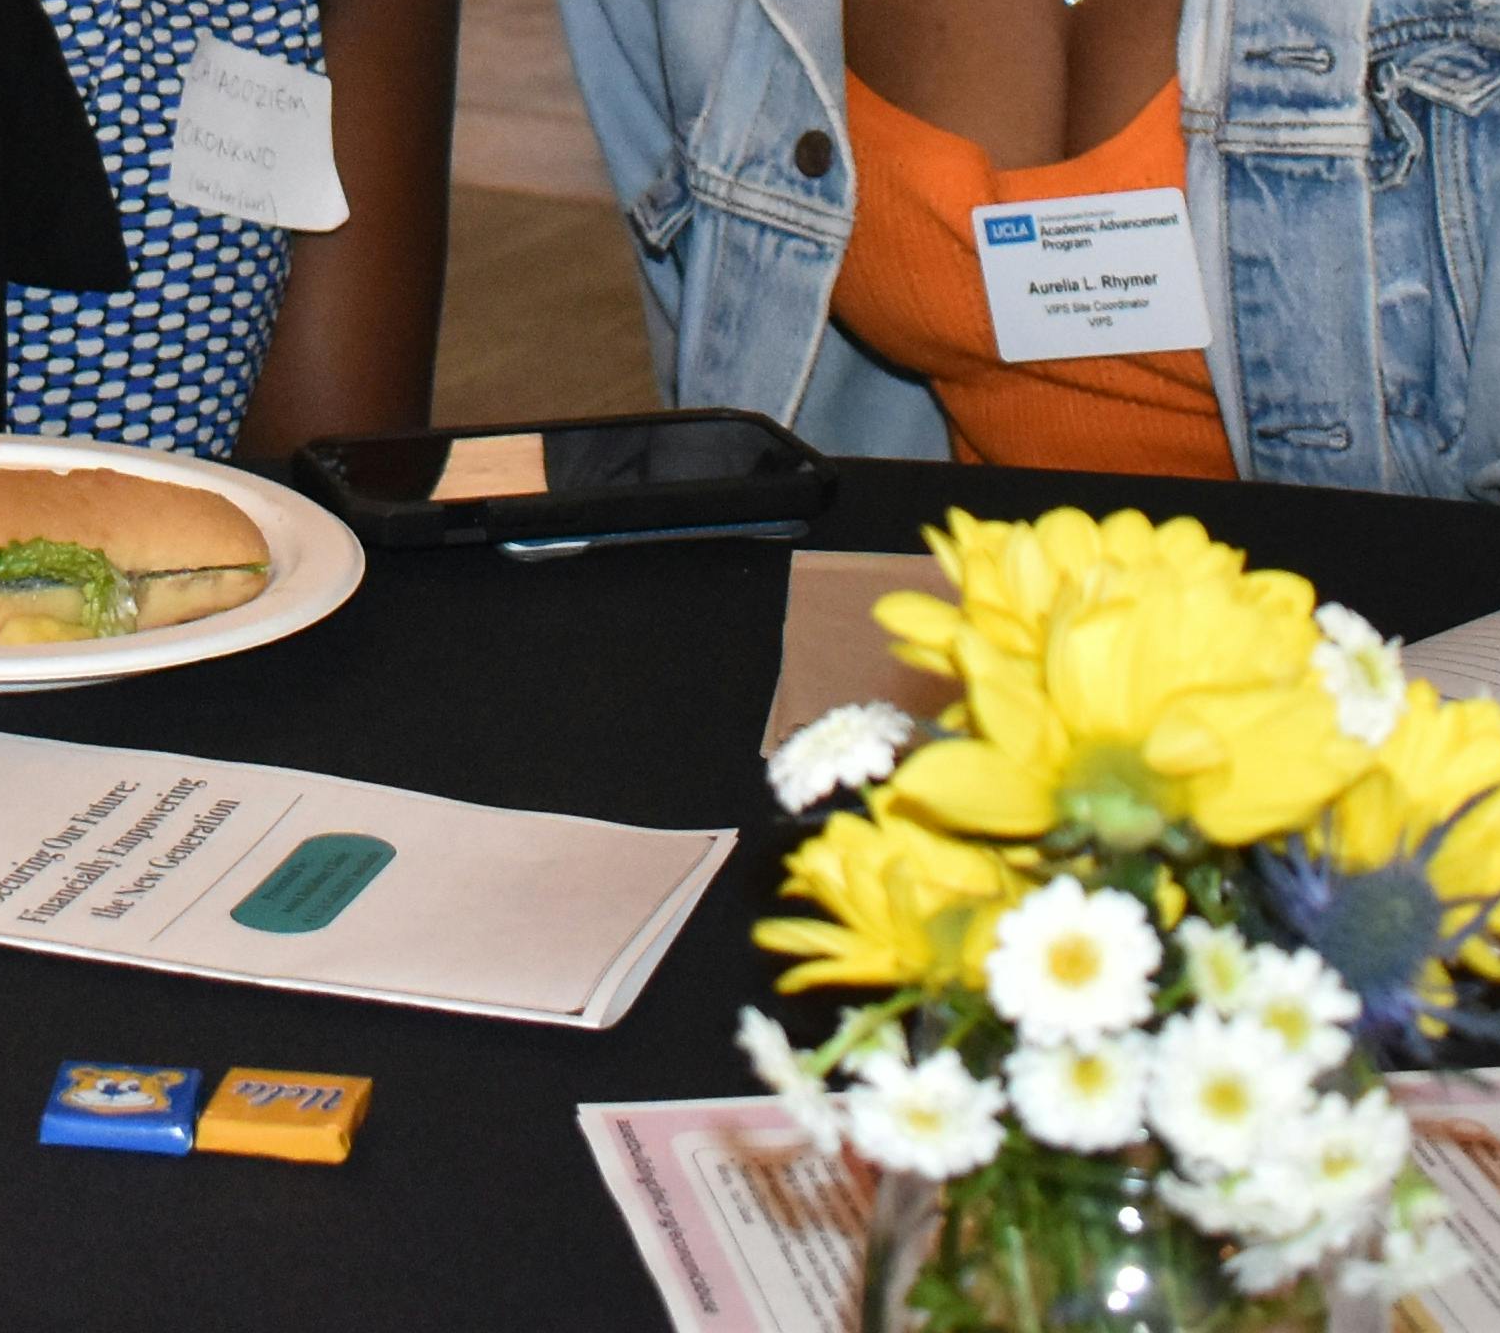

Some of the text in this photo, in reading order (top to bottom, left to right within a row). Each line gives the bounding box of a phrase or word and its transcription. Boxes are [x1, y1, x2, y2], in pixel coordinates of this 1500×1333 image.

[992, 222, 1030, 239] UCLA
[1039, 221, 1095, 237] Academic
[1099, 213, 1179, 231] Advancement
[1041, 236, 1093, 251] Program
[1028, 273, 1158, 295] Aurelia L. Rhymer
[17, 776, 209, 925] Financially Empowering
[42, 824, 88, 858] Our
[90, 798, 242, 921] the New Generation
